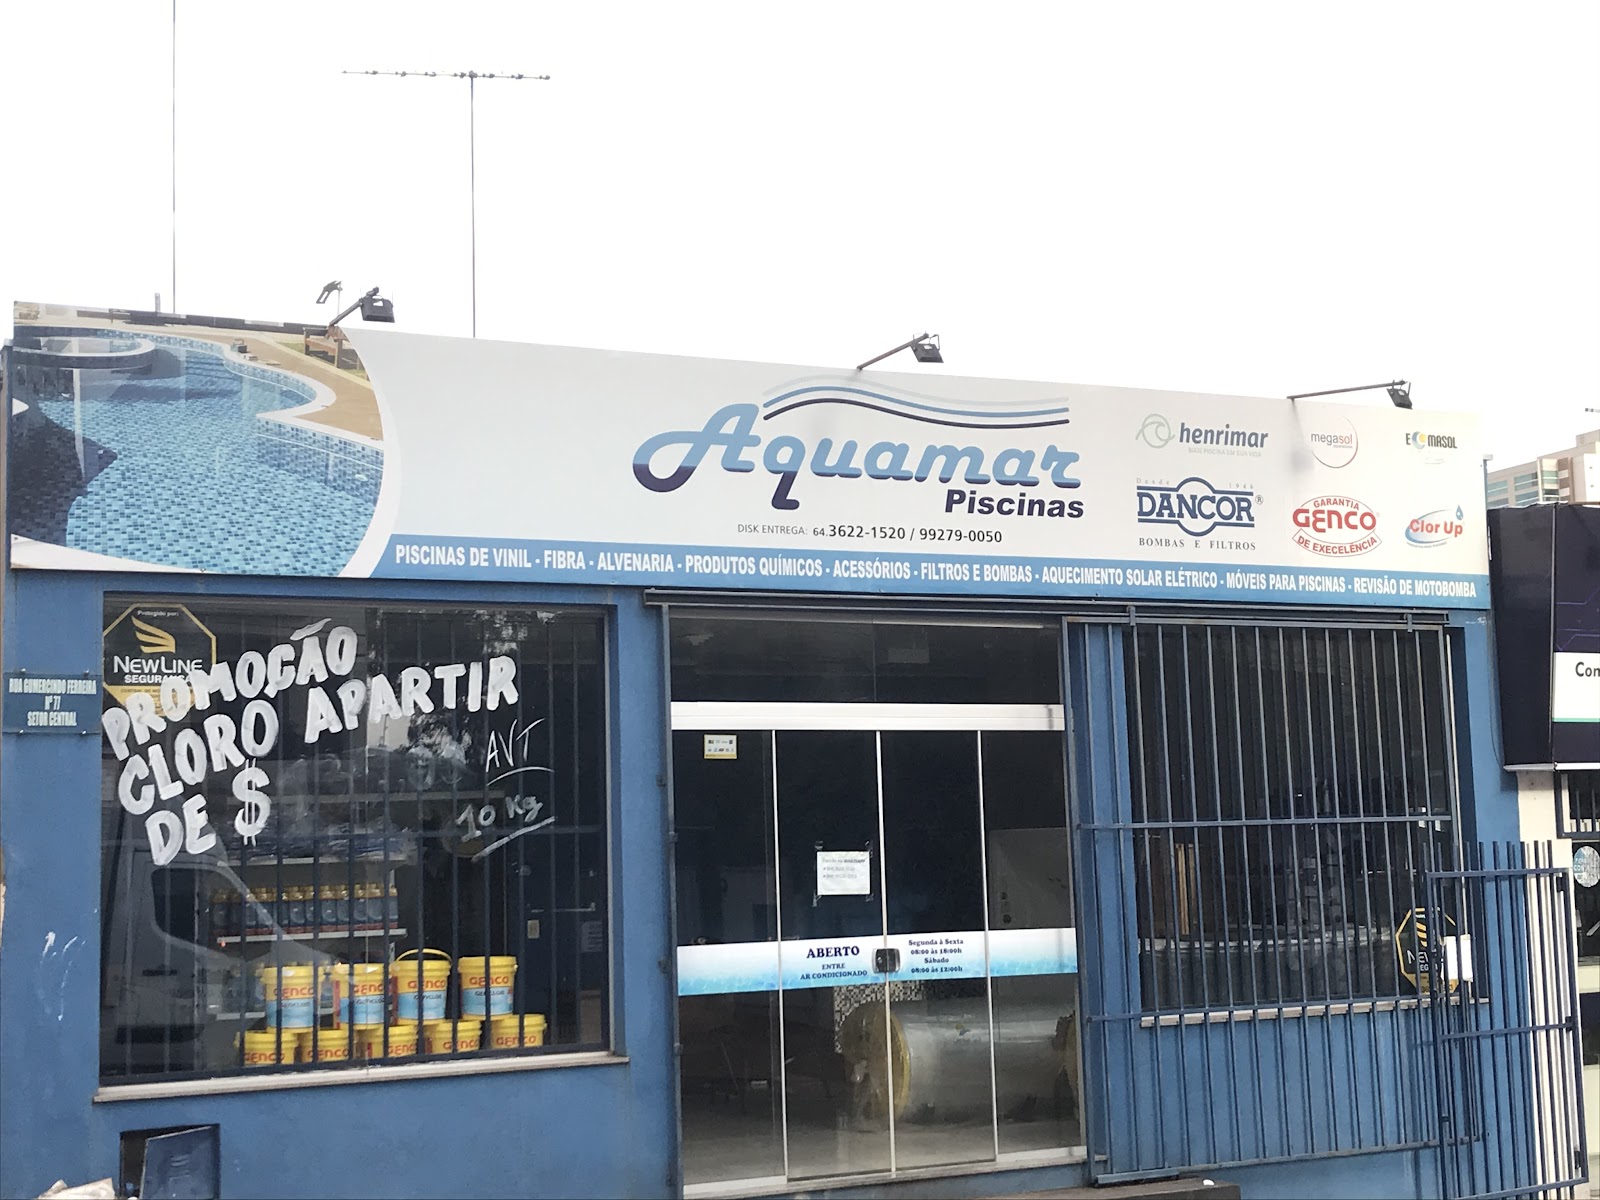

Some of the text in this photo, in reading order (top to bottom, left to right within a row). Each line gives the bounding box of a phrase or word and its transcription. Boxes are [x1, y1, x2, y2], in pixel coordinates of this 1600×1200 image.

[1179, 422, 1269, 448] henrimar
[1310, 432, 1353, 446] megasol
[632, 402, 1082, 510] Aquamar
[944, 489, 1085, 519] Piscinas
[1136, 491, 1255, 522] DANCOR
[1313, 497, 1360, 511] GARANTIA
[1292, 508, 1377, 533] GENCO
[1409, 519, 1463, 538] Clor Up
[737, 523, 760, 534] DISK
[761, 524, 808, 536] ENTREGA:
[919, 527, 1003, 543] 99279-0050
[1297, 535, 1312, 549] DE
[1138, 537, 1256, 551] BOMBAS E FILTROS
[395, 545, 465, 566] PISCINAS
[469, 547, 489, 568] DE
[493, 548, 532, 568] VINIL
[543, 549, 586, 570] FIBRA
[597, 552, 674, 573] ALVENARIA
[685, 555, 756, 575] PRODUTOS
[759, 553, 823, 577] QUÍMICOS
[833, 556, 911, 580] ACESSÓRIOS
[921, 562, 970, 582] FILTROS
[973, 564, 981, 582] E
[984, 564, 1033, 583] BOMBAS
[1041, 566, 1123, 586] AQUECIMENTO
[1126, 569, 1163, 587] SOLAR
[1165, 566, 1218, 588] ELÉTRICO
[1226, 569, 1267, 590] MÓVEIS
[1269, 574, 1297, 591] PARA
[1299, 575, 1346, 593] PISCINAS
[1354, 574, 1397, 595] REVISÃO
[1400, 578, 1414, 595] DE
[1415, 580, 1477, 598] MOTOBOMBA
[102, 617, 358, 761] PROMOÇÃO
[27, 711, 77, 727] SETOR CENTRAL
[486, 717, 546, 772] AVT
[118, 699, 279, 815] CLORO
[145, 793, 216, 866] DE
[455, 804, 497, 842] 10
[806, 945, 860, 959] ABERTO
[908, 939, 938, 947] Segunda
[924, 956, 950, 964] Sábado
[407, 979, 446, 990] GNCO
[800, 970, 868, 981] AR CONDICIONADO
[353, 983, 385, 995] GENC
